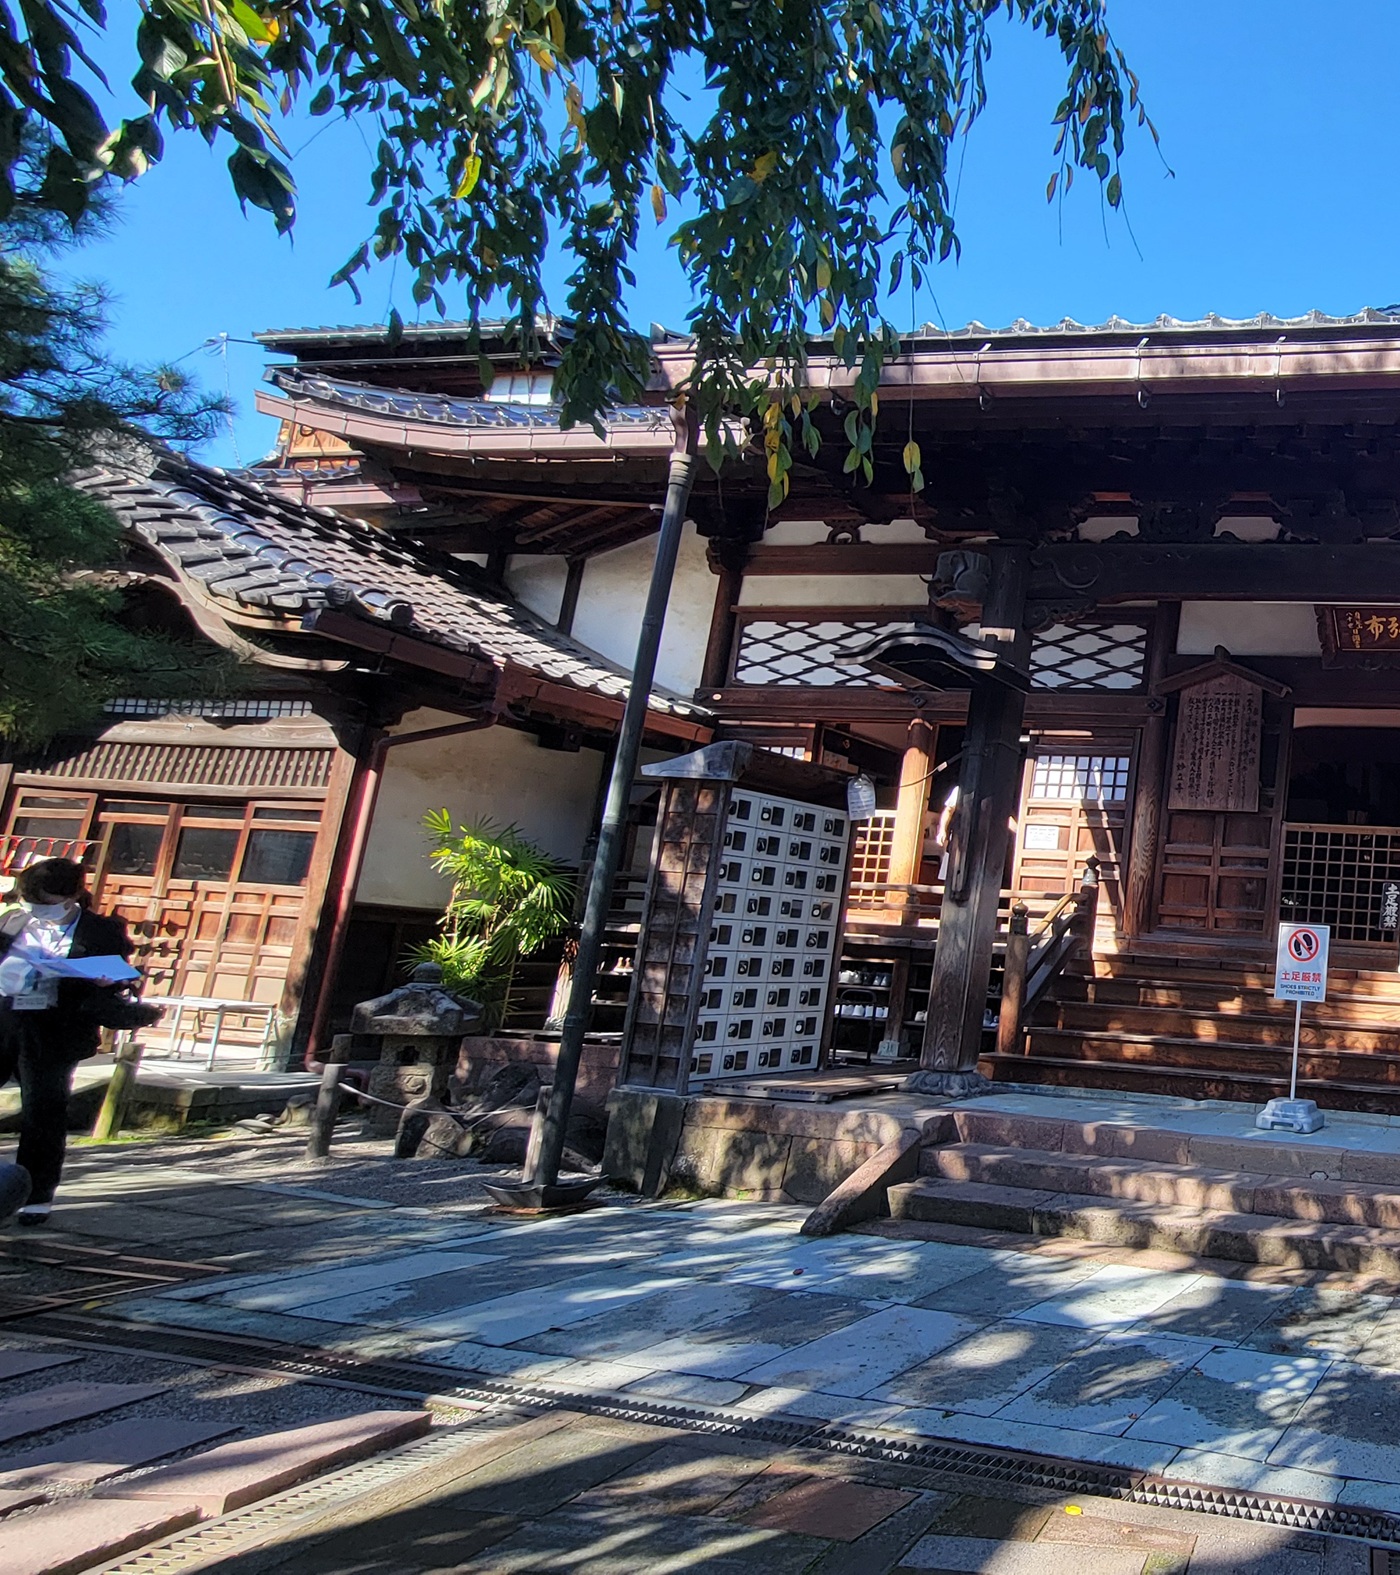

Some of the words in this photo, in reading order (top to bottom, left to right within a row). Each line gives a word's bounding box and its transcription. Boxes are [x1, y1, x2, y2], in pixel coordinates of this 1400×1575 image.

[1382, 884, 1400, 928] 土足厳禁
[1281, 971, 1322, 983] 土足厳禁
[1285, 989, 1315, 997] PROHIBITED
[1297, 984, 1321, 992] STRICTLY
